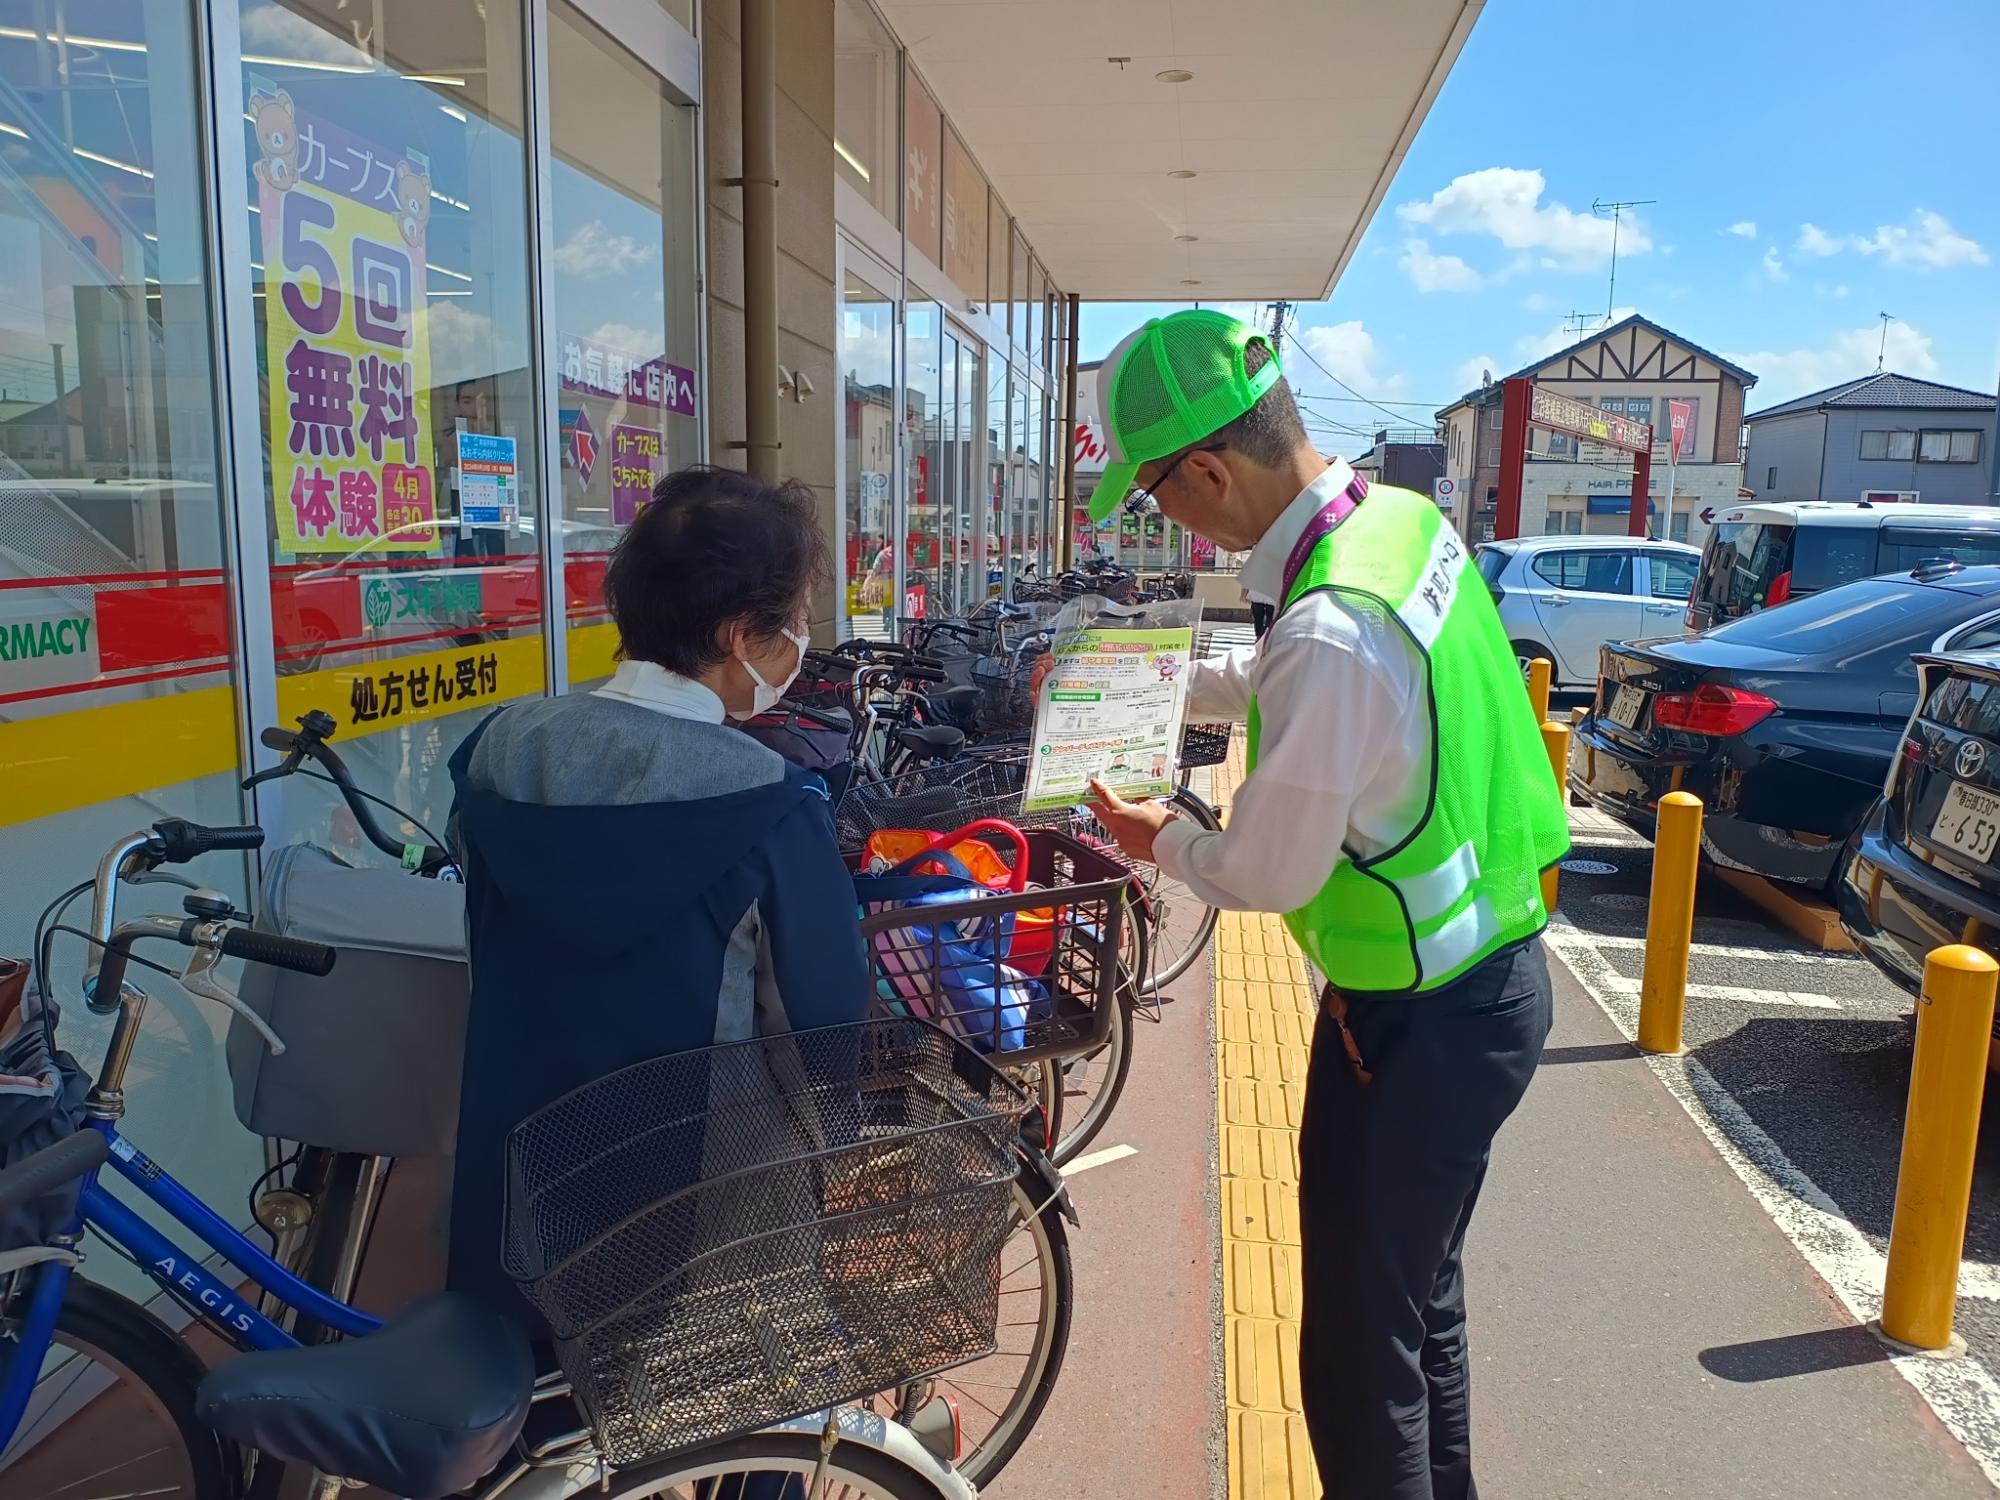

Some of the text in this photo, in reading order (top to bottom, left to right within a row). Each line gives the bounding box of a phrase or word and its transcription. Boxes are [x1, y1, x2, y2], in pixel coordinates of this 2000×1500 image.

[299, 124, 402, 213] カーブス
[281, 191, 413, 348] 5回
[286, 339, 418, 464] 無料
[565, 341, 694, 407] お気軽に店内へ
[617, 431, 659, 458] カーブスは
[291, 466, 379, 537] 体験
[394, 470, 419, 500] 4月
[1588, 481, 1612, 489] HAIR
[0, 618, 90, 661] RMACY
[351, 653, 498, 725] 処方せん受付
[155, 1257, 254, 1332] AEGIS
